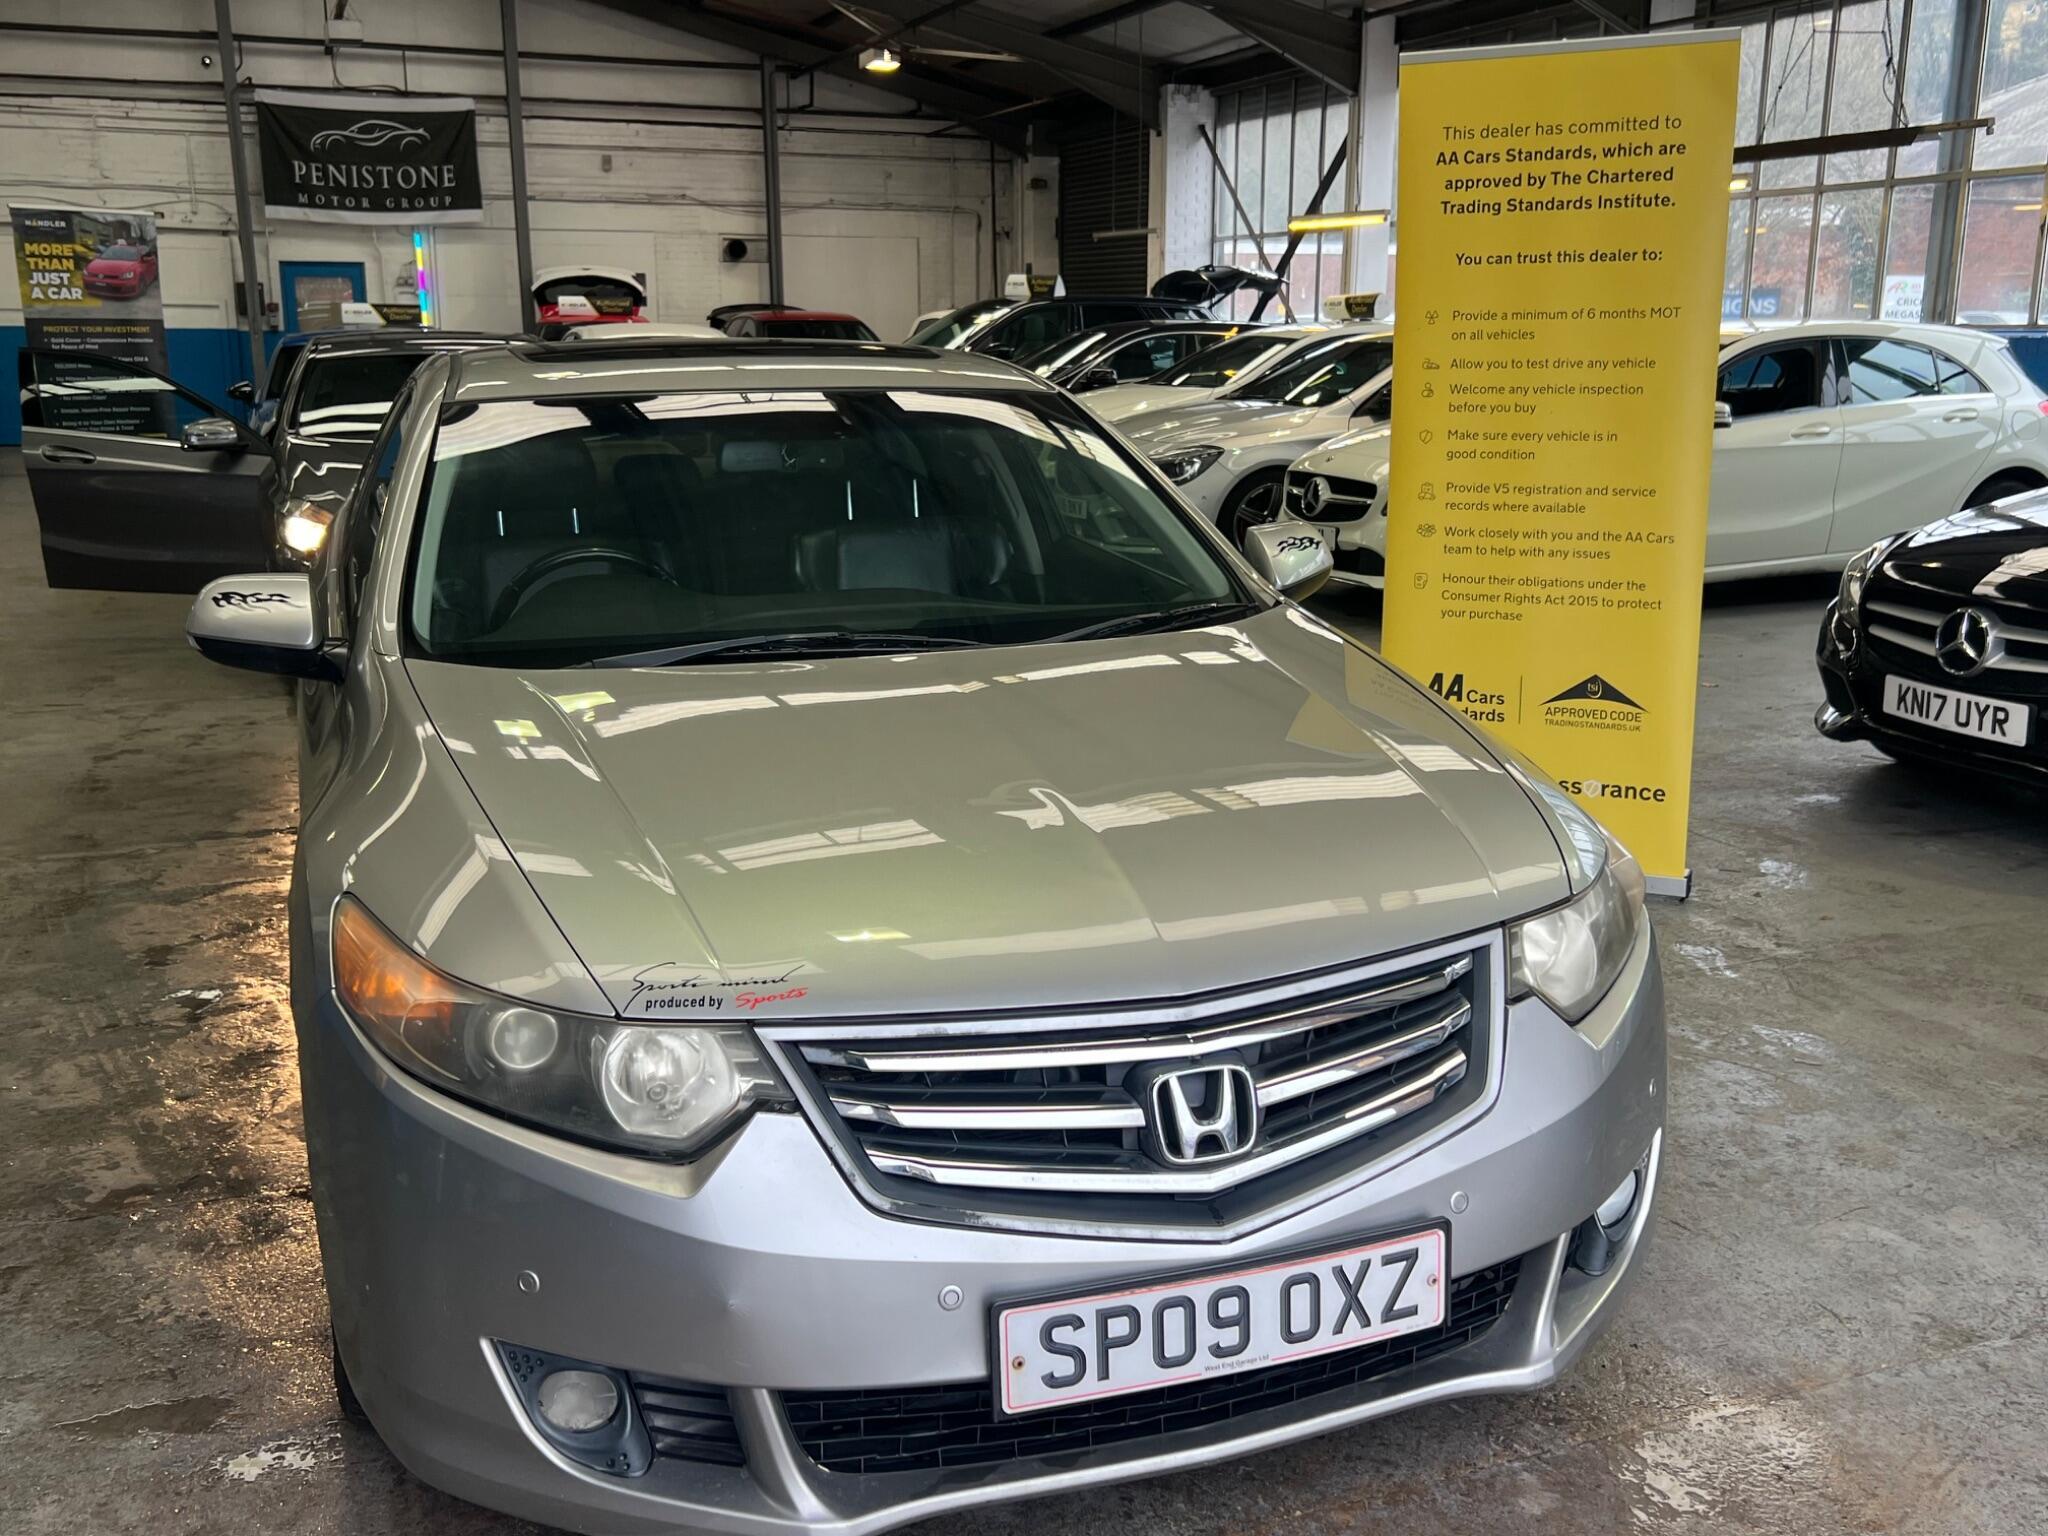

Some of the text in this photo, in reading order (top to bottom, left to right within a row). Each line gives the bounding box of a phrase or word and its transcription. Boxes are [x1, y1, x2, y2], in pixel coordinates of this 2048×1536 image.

[1443, 115, 1682, 141] This dealer has committed to
[1436, 141, 1687, 166] AA Cars Standards, which are
[291, 160, 457, 189] PENISTONE
[1445, 166, 1675, 192] approved by The Chartered
[298, 193, 453, 209] MOTOR GROUP
[1441, 192, 1676, 216] Trading Standards Institute.
[24, 242, 74, 256] MORE
[26, 258, 75, 271] THAN
[1456, 248, 1663, 266] You can trust this dealer to:
[29, 272, 71, 285] JUST
[31, 287, 83, 300] A CAR
[1897, 297, 1922, 306] CRIC
[1452, 306, 1682, 321] Provide a minimum of 6 months MOT
[1885, 310, 1923, 320] MEGAS
[43, 325, 150, 333] PROTECT YOUR INVESTMENT
[1451, 329, 1535, 341] on all vehicles
[1450, 357, 1656, 371] Allow you to test drive any vehicle
[1449, 383, 1644, 397] Welcome any vehicle inspection
[1449, 402, 1536, 415] before you buy
[1447, 430, 1618, 443] Make sure every vehicle is in
[1446, 449, 1536, 461] good condition
[1446, 482, 1657, 497] Provide V5 registration and service
[1445, 500, 1586, 513] records where available
[1444, 526, 1675, 544] Work closely with you and the AA Cars
[1443, 544, 1611, 560] team to help with any issues
[1442, 572, 1646, 592] Honour their obligations under the
[1441, 589, 1663, 610] Consumer Rights Act 2015 to protect
[1440, 607, 1524, 621] your purchase
[1428, 672, 1464, 703] AA
[1466, 689, 1505, 706] Cars
[1544, 706, 1642, 723] APPROVED CODE
[1896, 683, 2010, 737] KN17 UYR
[1544, 718, 1641, 733] TRADINGSTANDARDS.UK
[645, 987, 809, 1012] produced by Sports
[1039, 1247, 1419, 1390] SP09 OXZ
